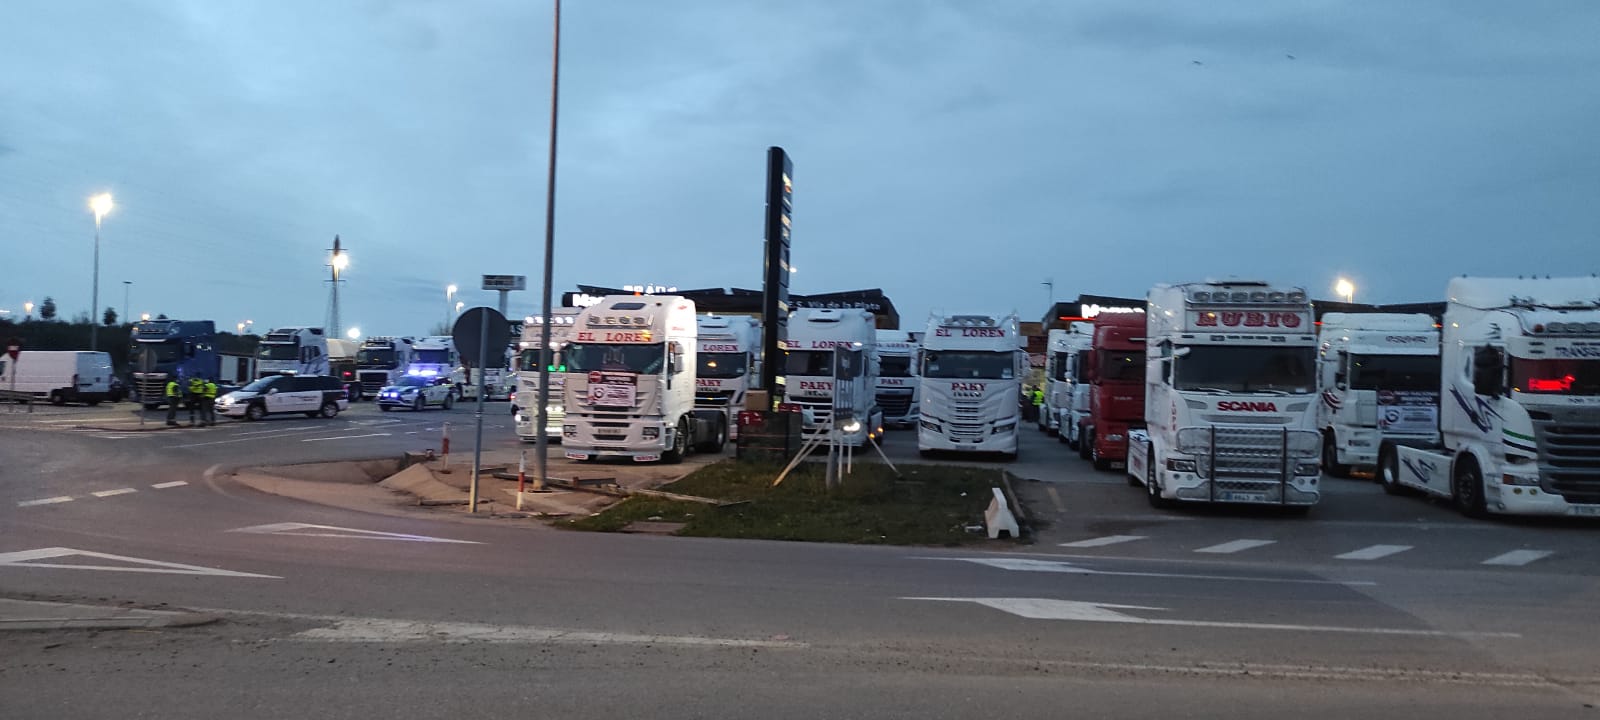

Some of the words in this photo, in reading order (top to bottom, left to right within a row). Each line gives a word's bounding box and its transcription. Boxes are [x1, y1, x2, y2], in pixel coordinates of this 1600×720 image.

[578, 332, 595, 341] EL
[935, 329, 952, 337] EL
[962, 329, 1005, 337] LOREN
[800, 382, 833, 390] PAKY
[951, 383, 987, 391] PAKY
[1217, 401, 1278, 412] SCANIA
